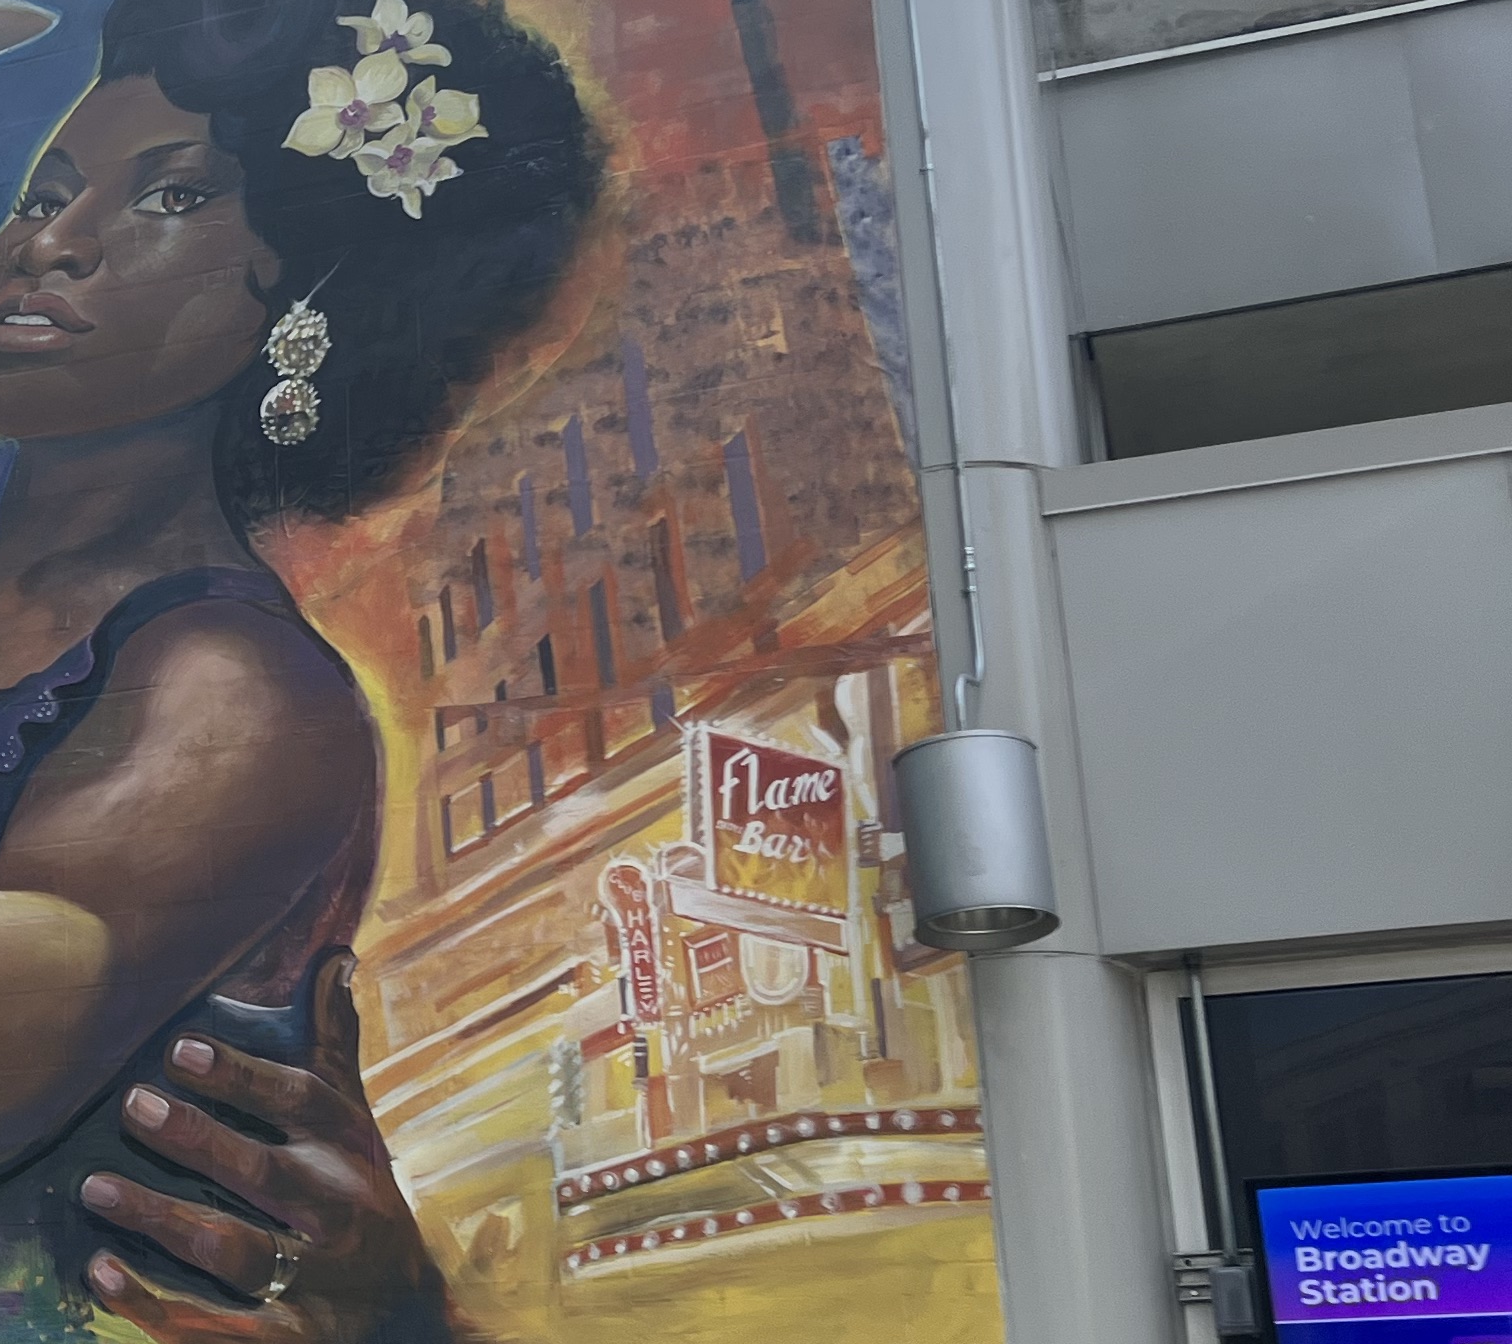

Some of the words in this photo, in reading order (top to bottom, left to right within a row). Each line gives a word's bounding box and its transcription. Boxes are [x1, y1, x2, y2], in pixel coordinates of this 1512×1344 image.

[732, 820, 812, 863] Bar
[626, 908, 659, 1016] HARLEY
[1289, 1217, 1432, 1241] Welcome
[1437, 1214, 1471, 1234] to
[1294, 1240, 1491, 1272] Broadway
[1298, 1273, 1439, 1306] Station
